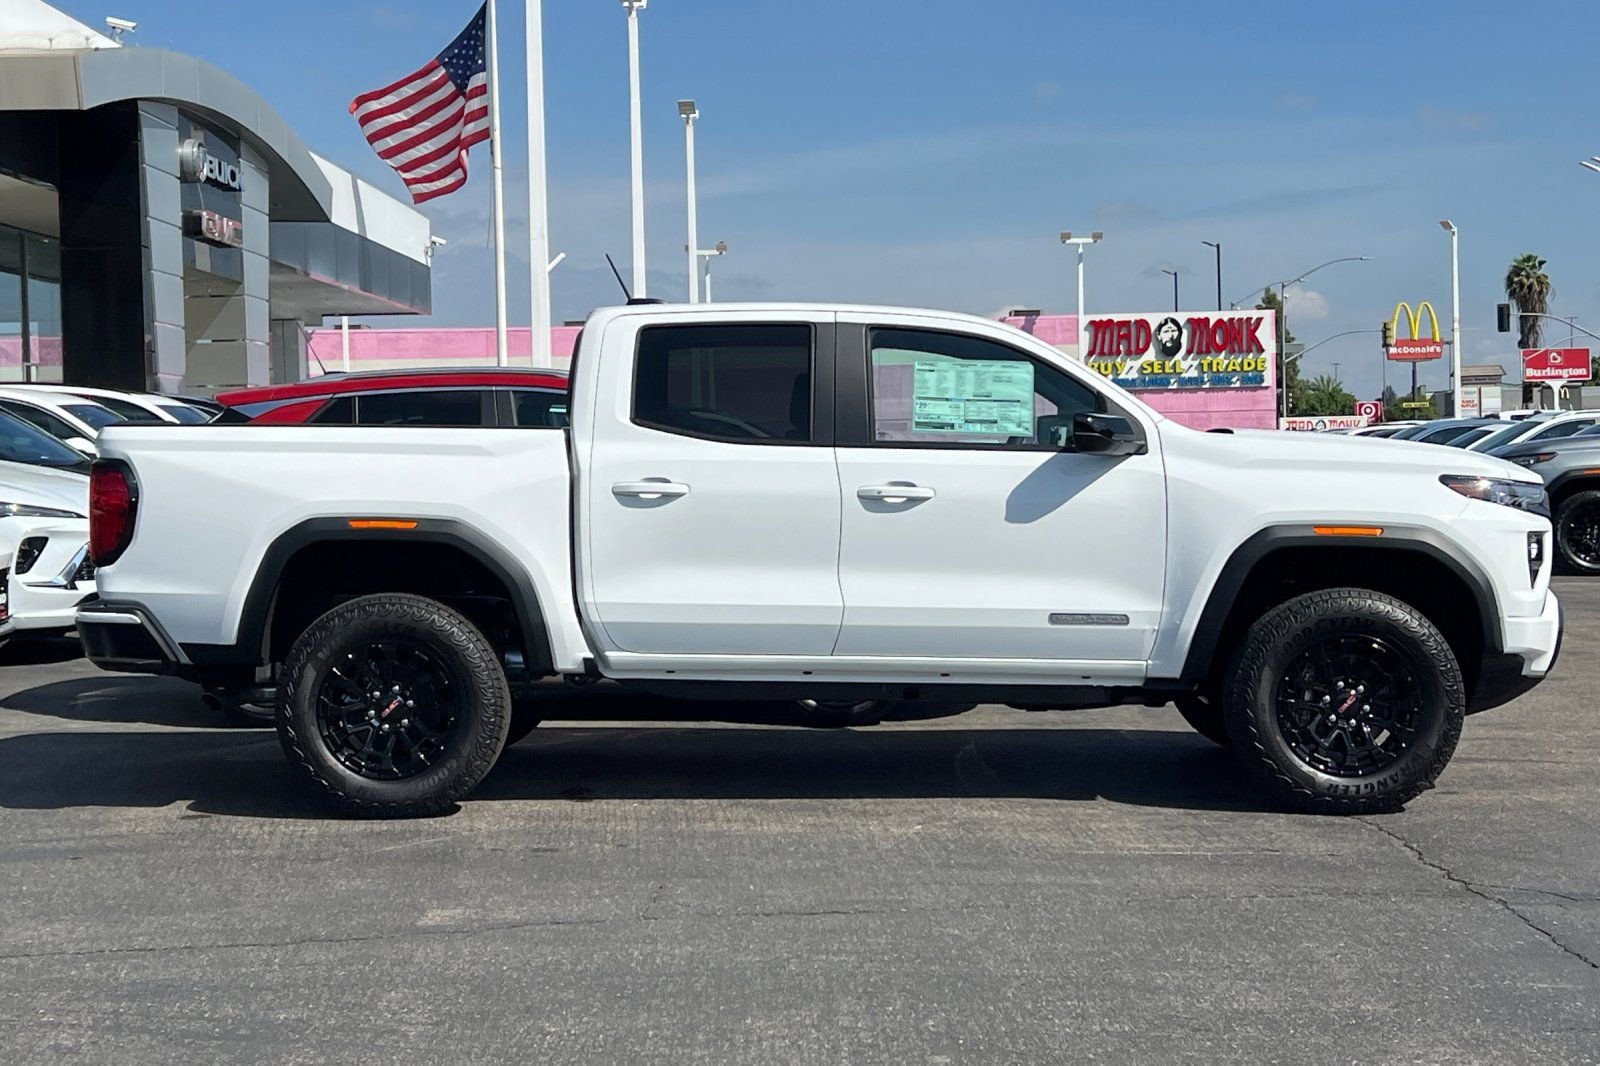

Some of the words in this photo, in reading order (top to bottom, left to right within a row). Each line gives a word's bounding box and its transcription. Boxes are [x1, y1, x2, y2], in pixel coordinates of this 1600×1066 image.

[1087, 318, 1153, 356] MAD
[1186, 316, 1266, 354] MONK
[1389, 345, 1442, 354] McDonald's
[1087, 360, 1127, 375] BUY
[1142, 359, 1185, 374] SELL
[1200, 357, 1267, 373] TRADE
[1525, 367, 1588, 379] Burlington
